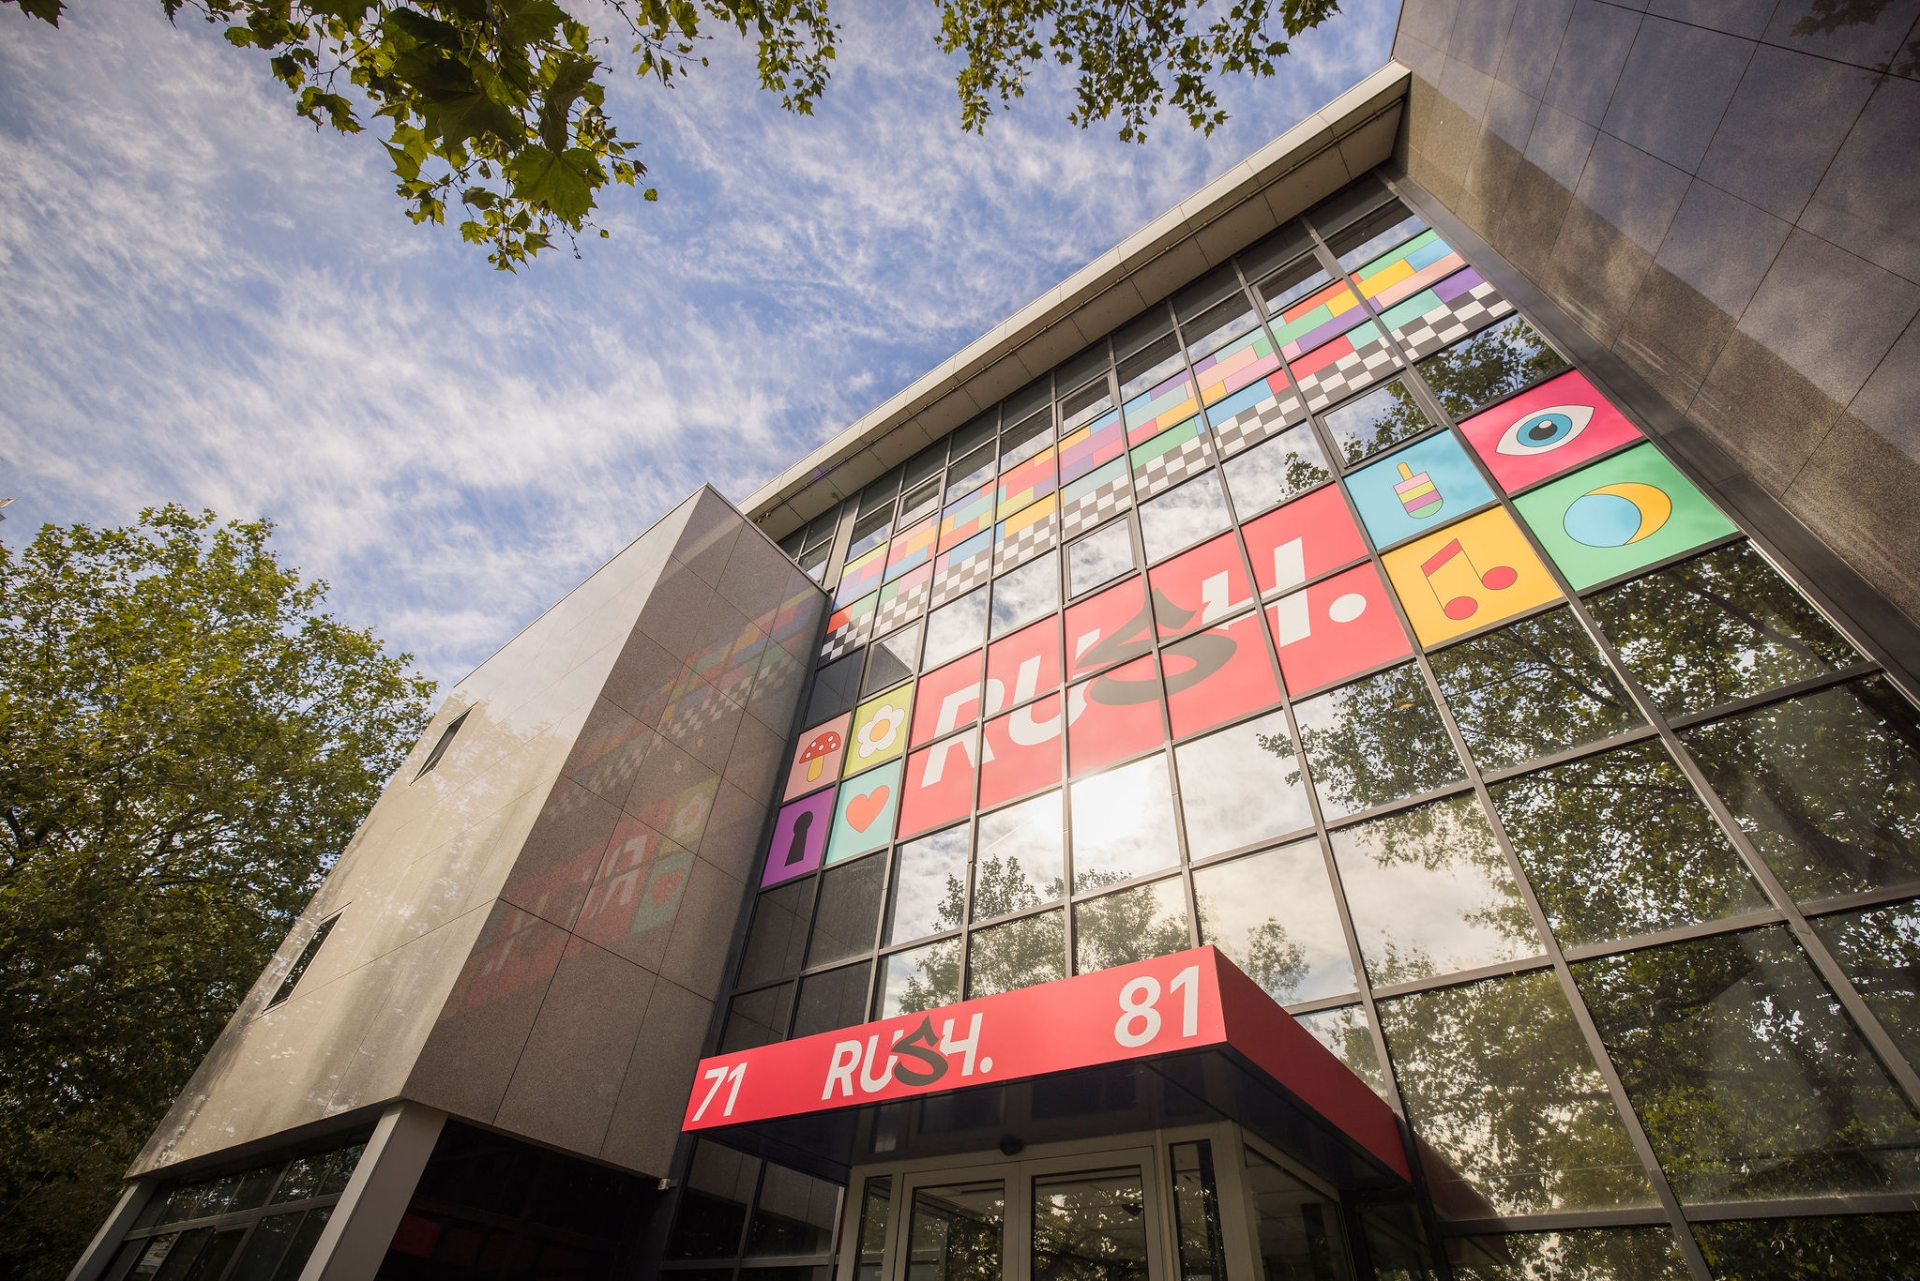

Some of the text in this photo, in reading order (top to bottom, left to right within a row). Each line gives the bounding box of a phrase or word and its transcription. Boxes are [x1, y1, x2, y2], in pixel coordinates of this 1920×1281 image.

[921, 537, 1367, 788] RUSH.
[692, 965, 1199, 1121] 71 RUSH. 81
